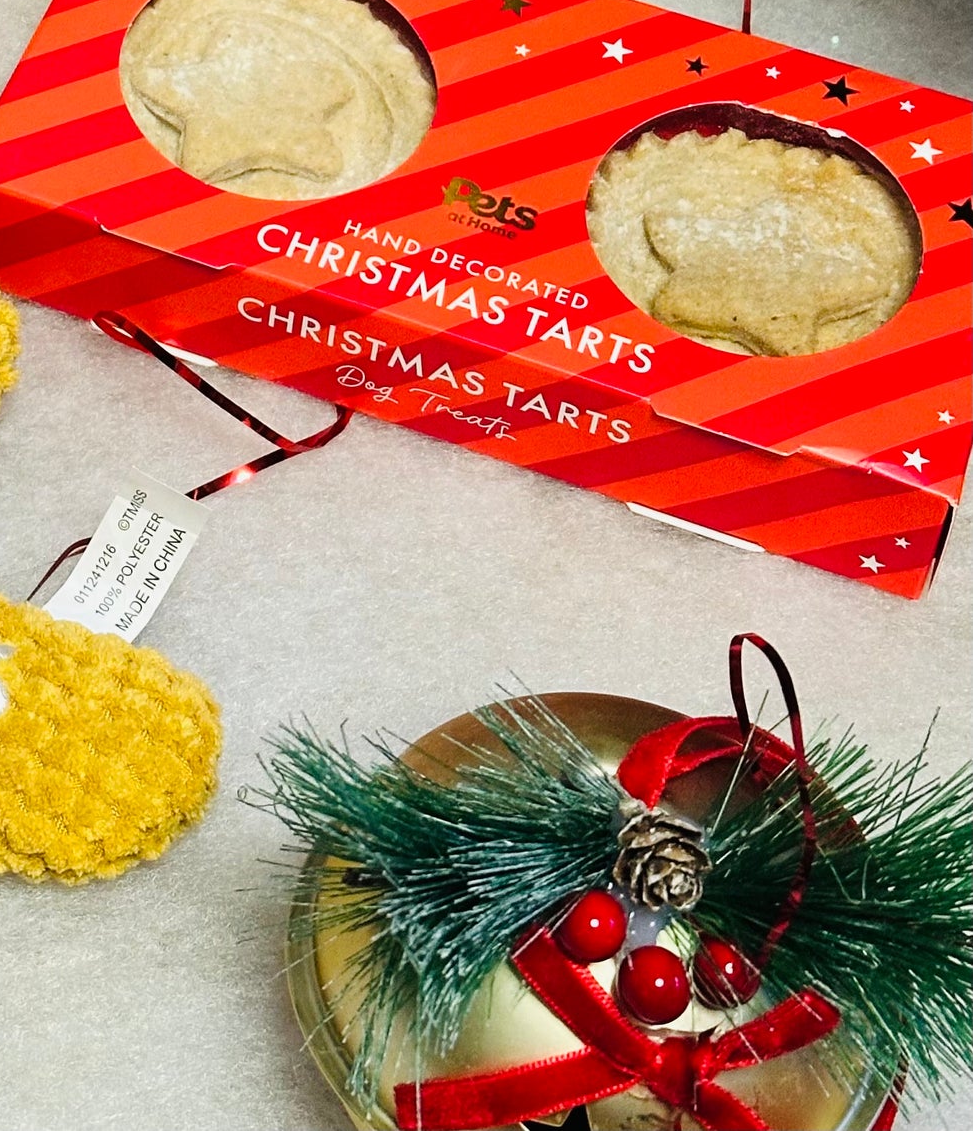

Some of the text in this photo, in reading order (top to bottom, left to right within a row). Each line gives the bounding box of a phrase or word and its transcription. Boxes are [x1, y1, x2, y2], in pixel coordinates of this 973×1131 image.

[442, 176, 538, 231] Pets
[448, 211, 517, 240] at Home
[256, 223, 656, 374] CHRISTMAS TARTS
[343, 220, 589, 310] HAND DECORATED
[237, 296, 631, 443] CHRISTMAS TARTS
[335, 364, 518, 441] Dog Treats
[74, 543, 116, 604] 011241216
[96, 512, 164, 616] 100% POLYESTER
[115, 528, 186, 631] MADE IN CHINA
